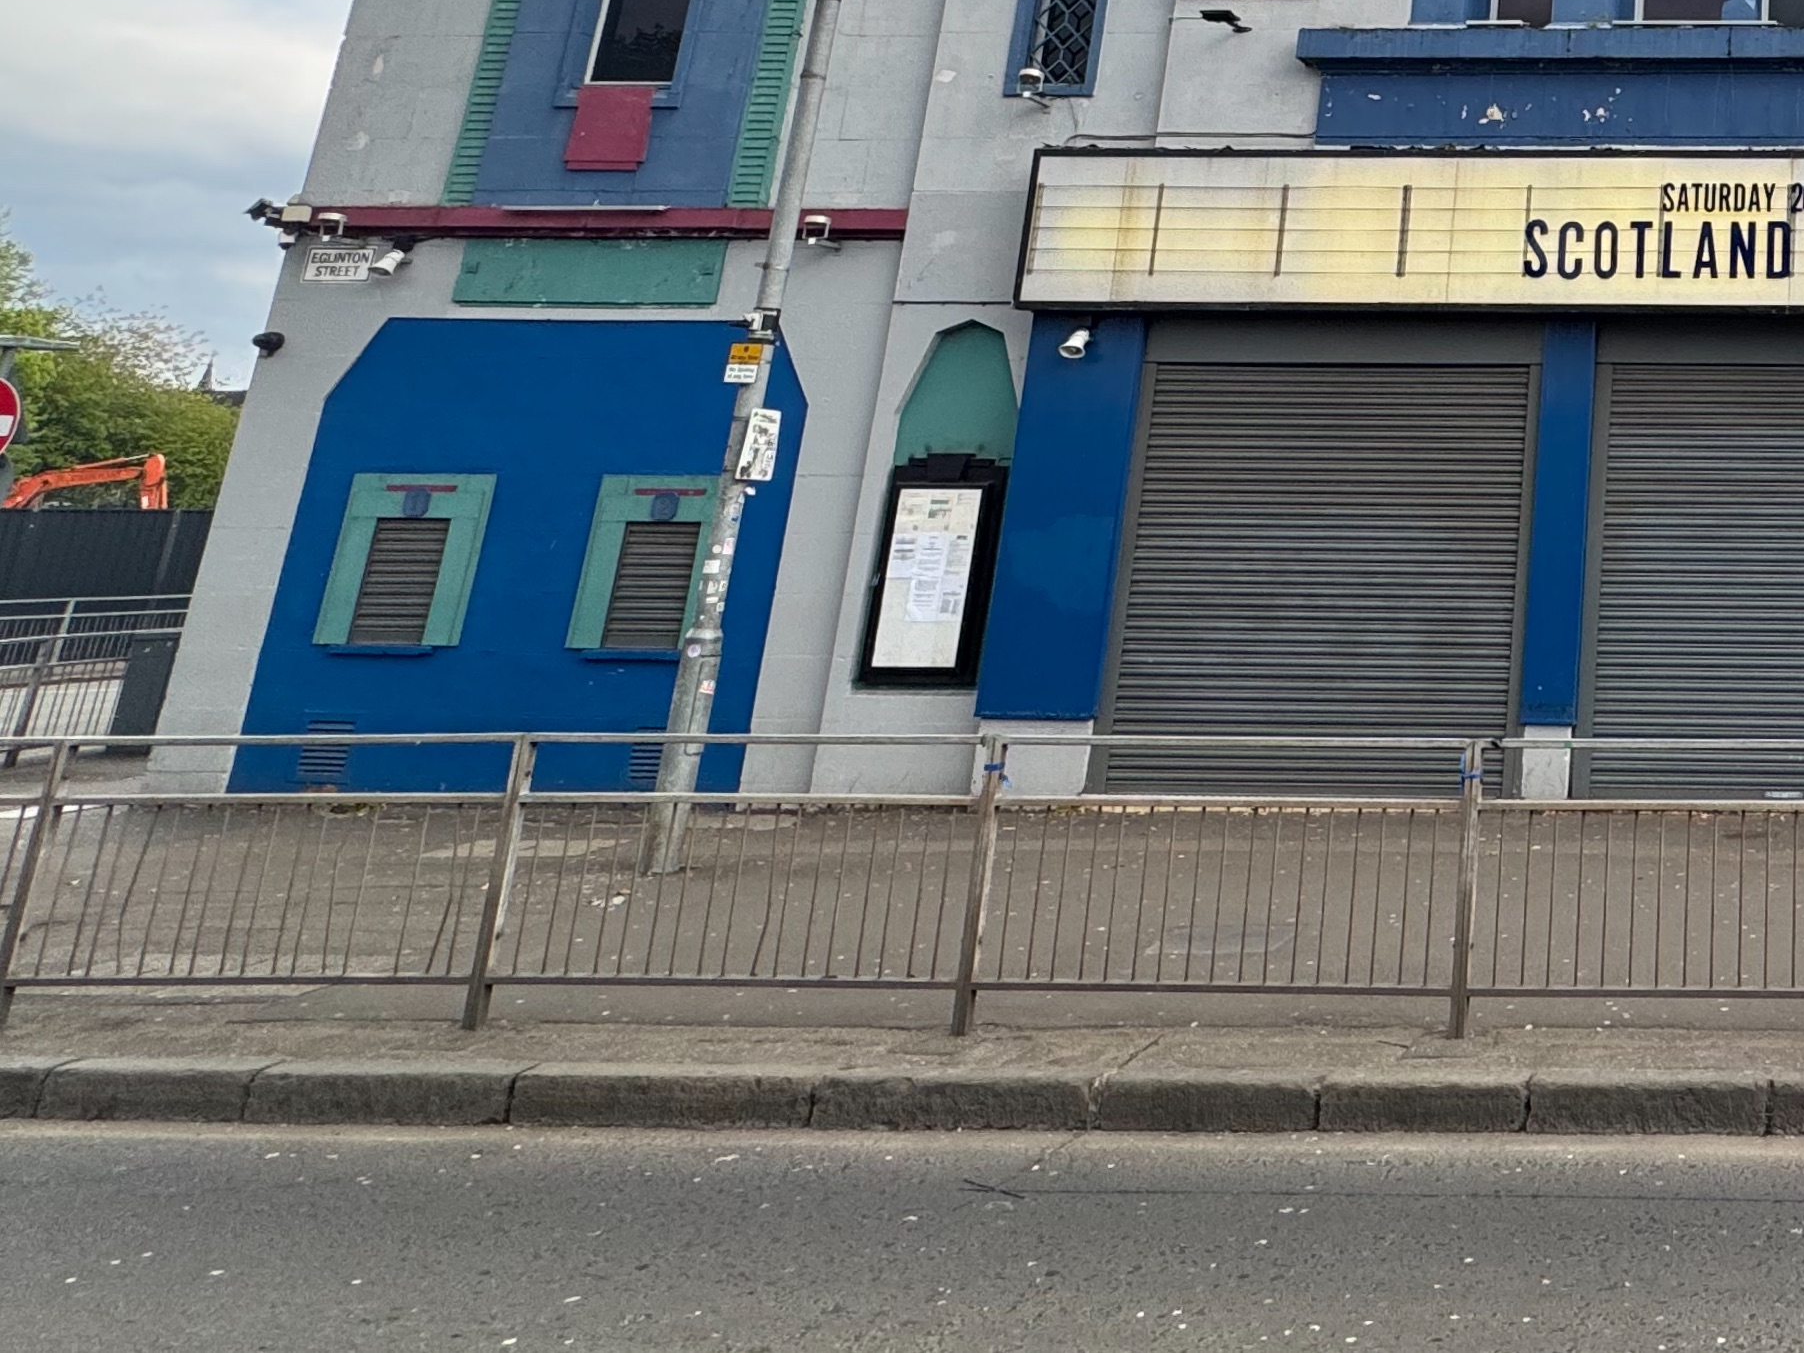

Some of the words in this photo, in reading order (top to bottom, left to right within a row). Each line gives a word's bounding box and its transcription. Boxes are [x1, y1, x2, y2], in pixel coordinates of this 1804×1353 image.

[1662, 183, 1776, 213] SATURDAY
[310, 251, 371, 264] EGLINTON
[1523, 220, 1794, 279] SCOTLAND
[314, 265, 361, 278] STREET
